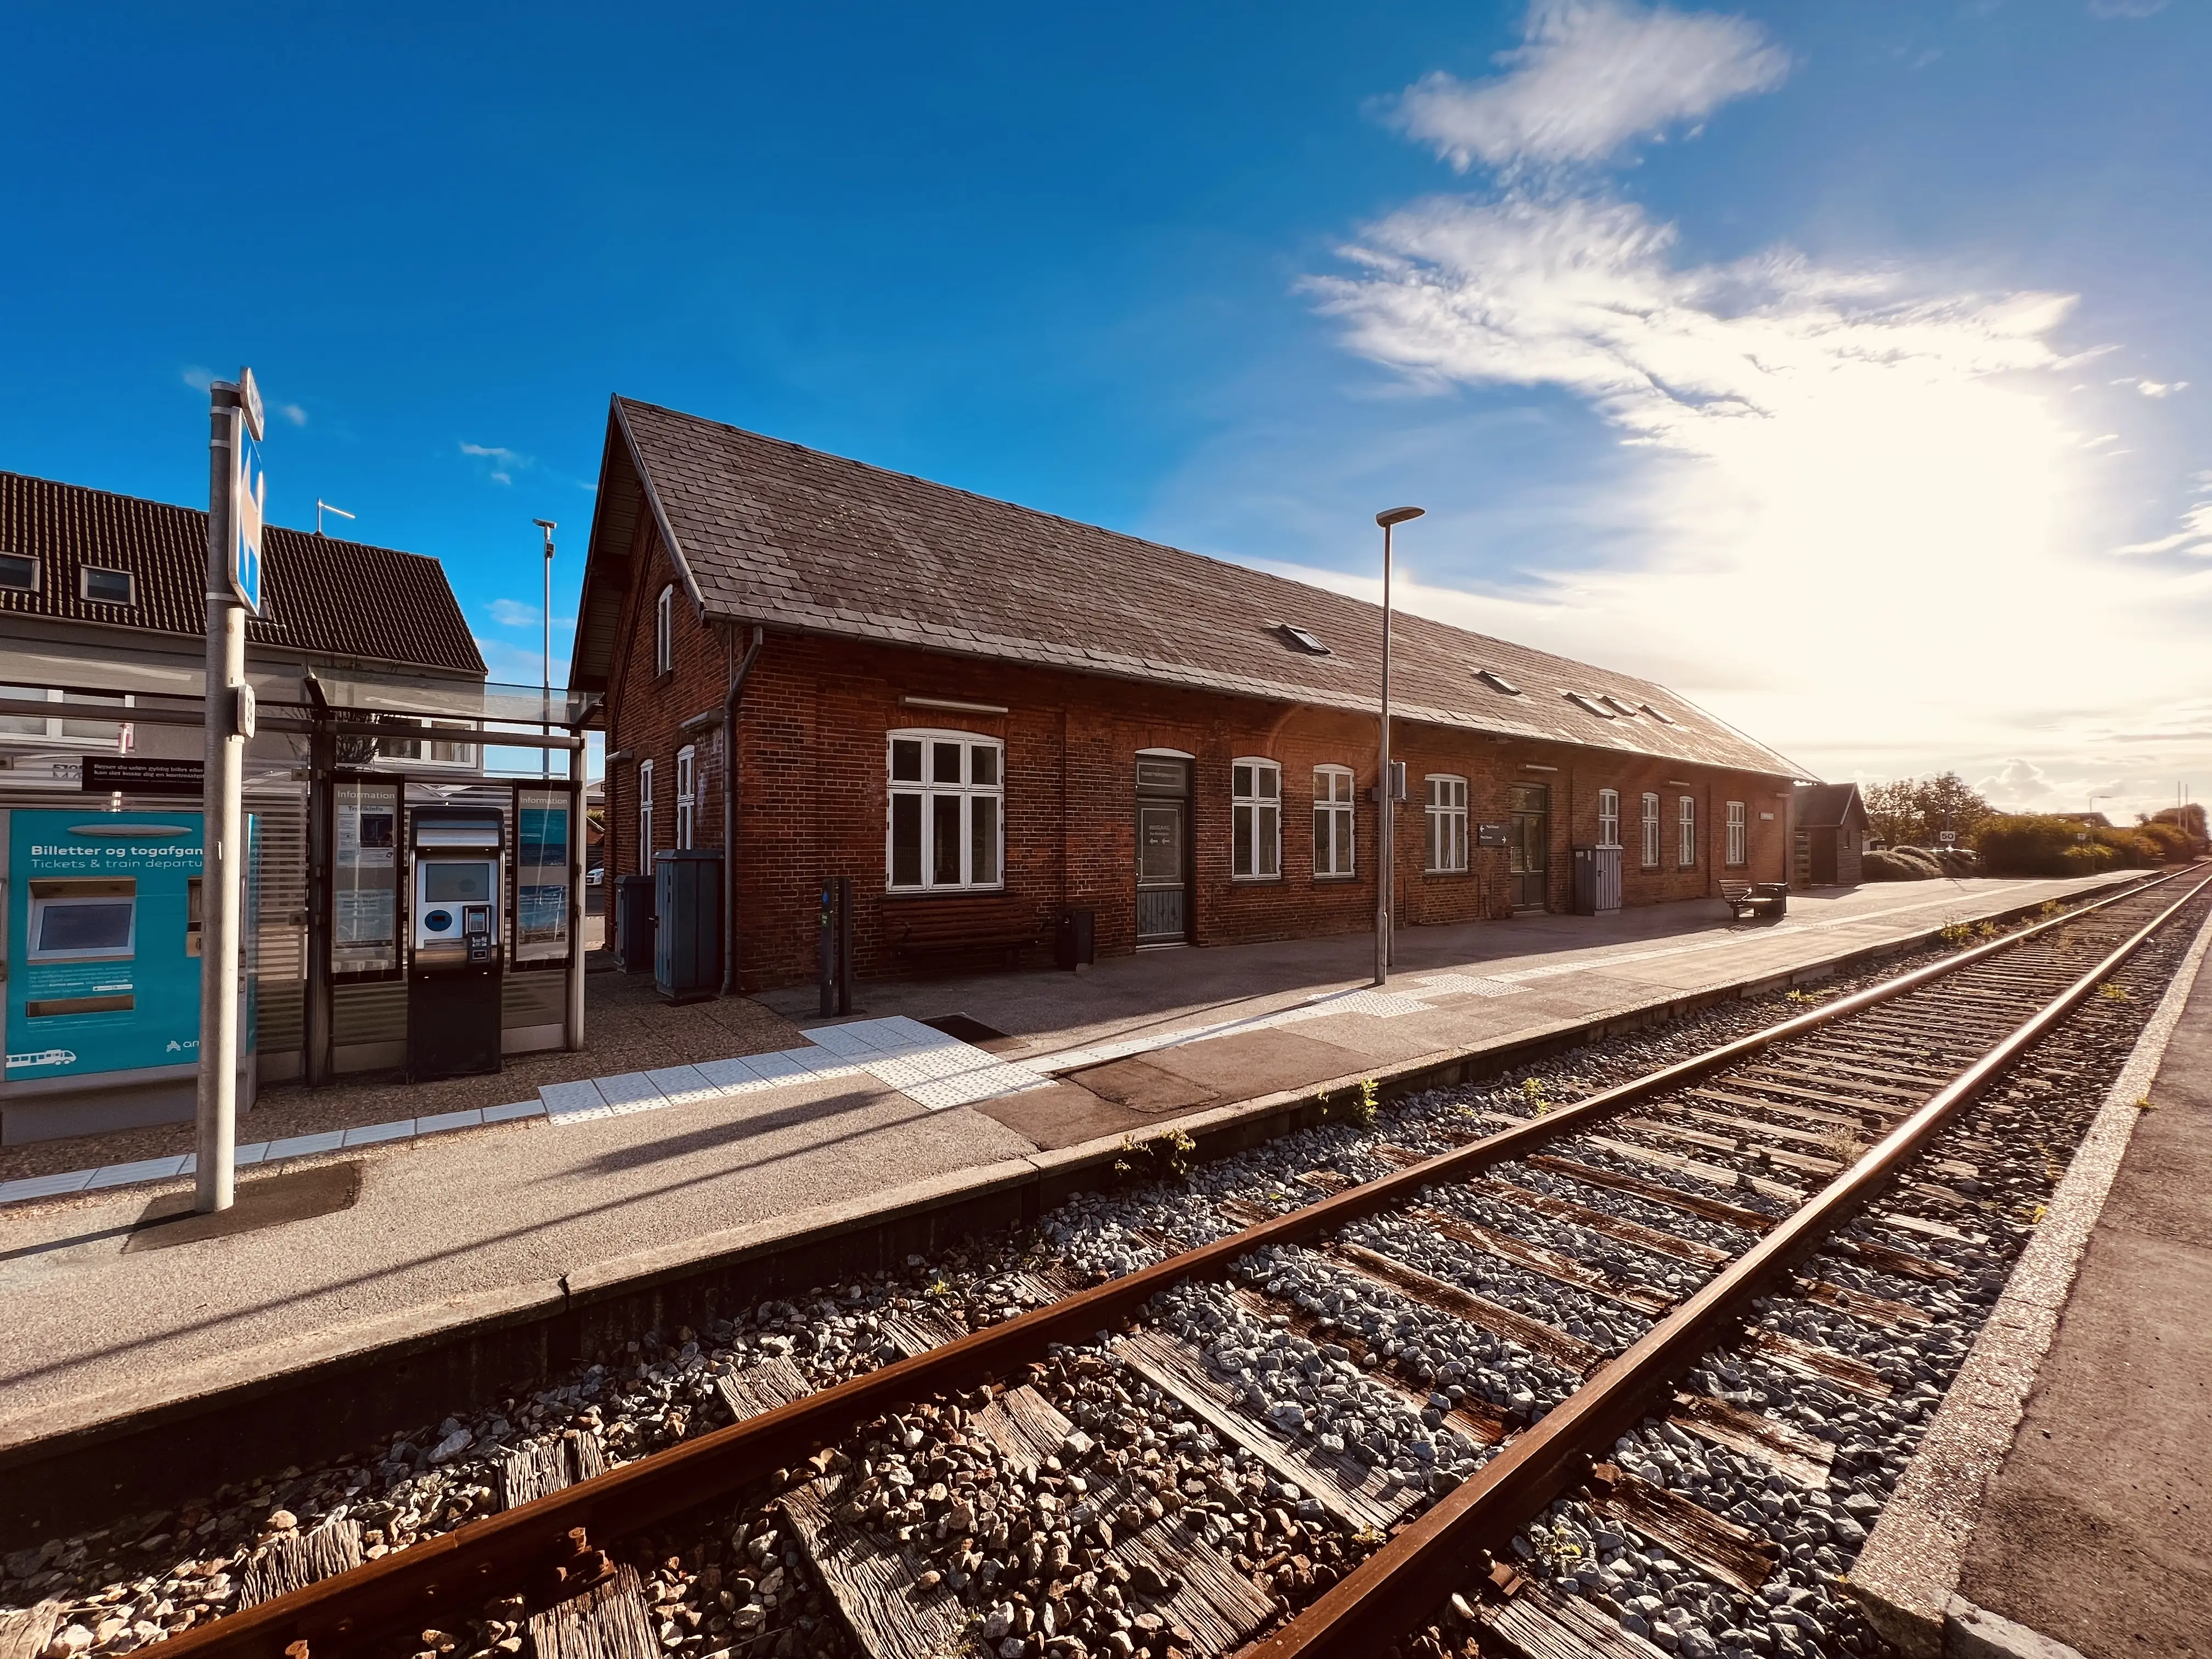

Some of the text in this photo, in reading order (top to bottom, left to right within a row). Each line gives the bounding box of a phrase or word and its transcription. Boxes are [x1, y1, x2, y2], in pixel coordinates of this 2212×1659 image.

[337, 790, 395, 799] Information
[31, 845, 203, 857] Billetter og togafgan
[31, 859, 202, 869] Tickets & train departu
